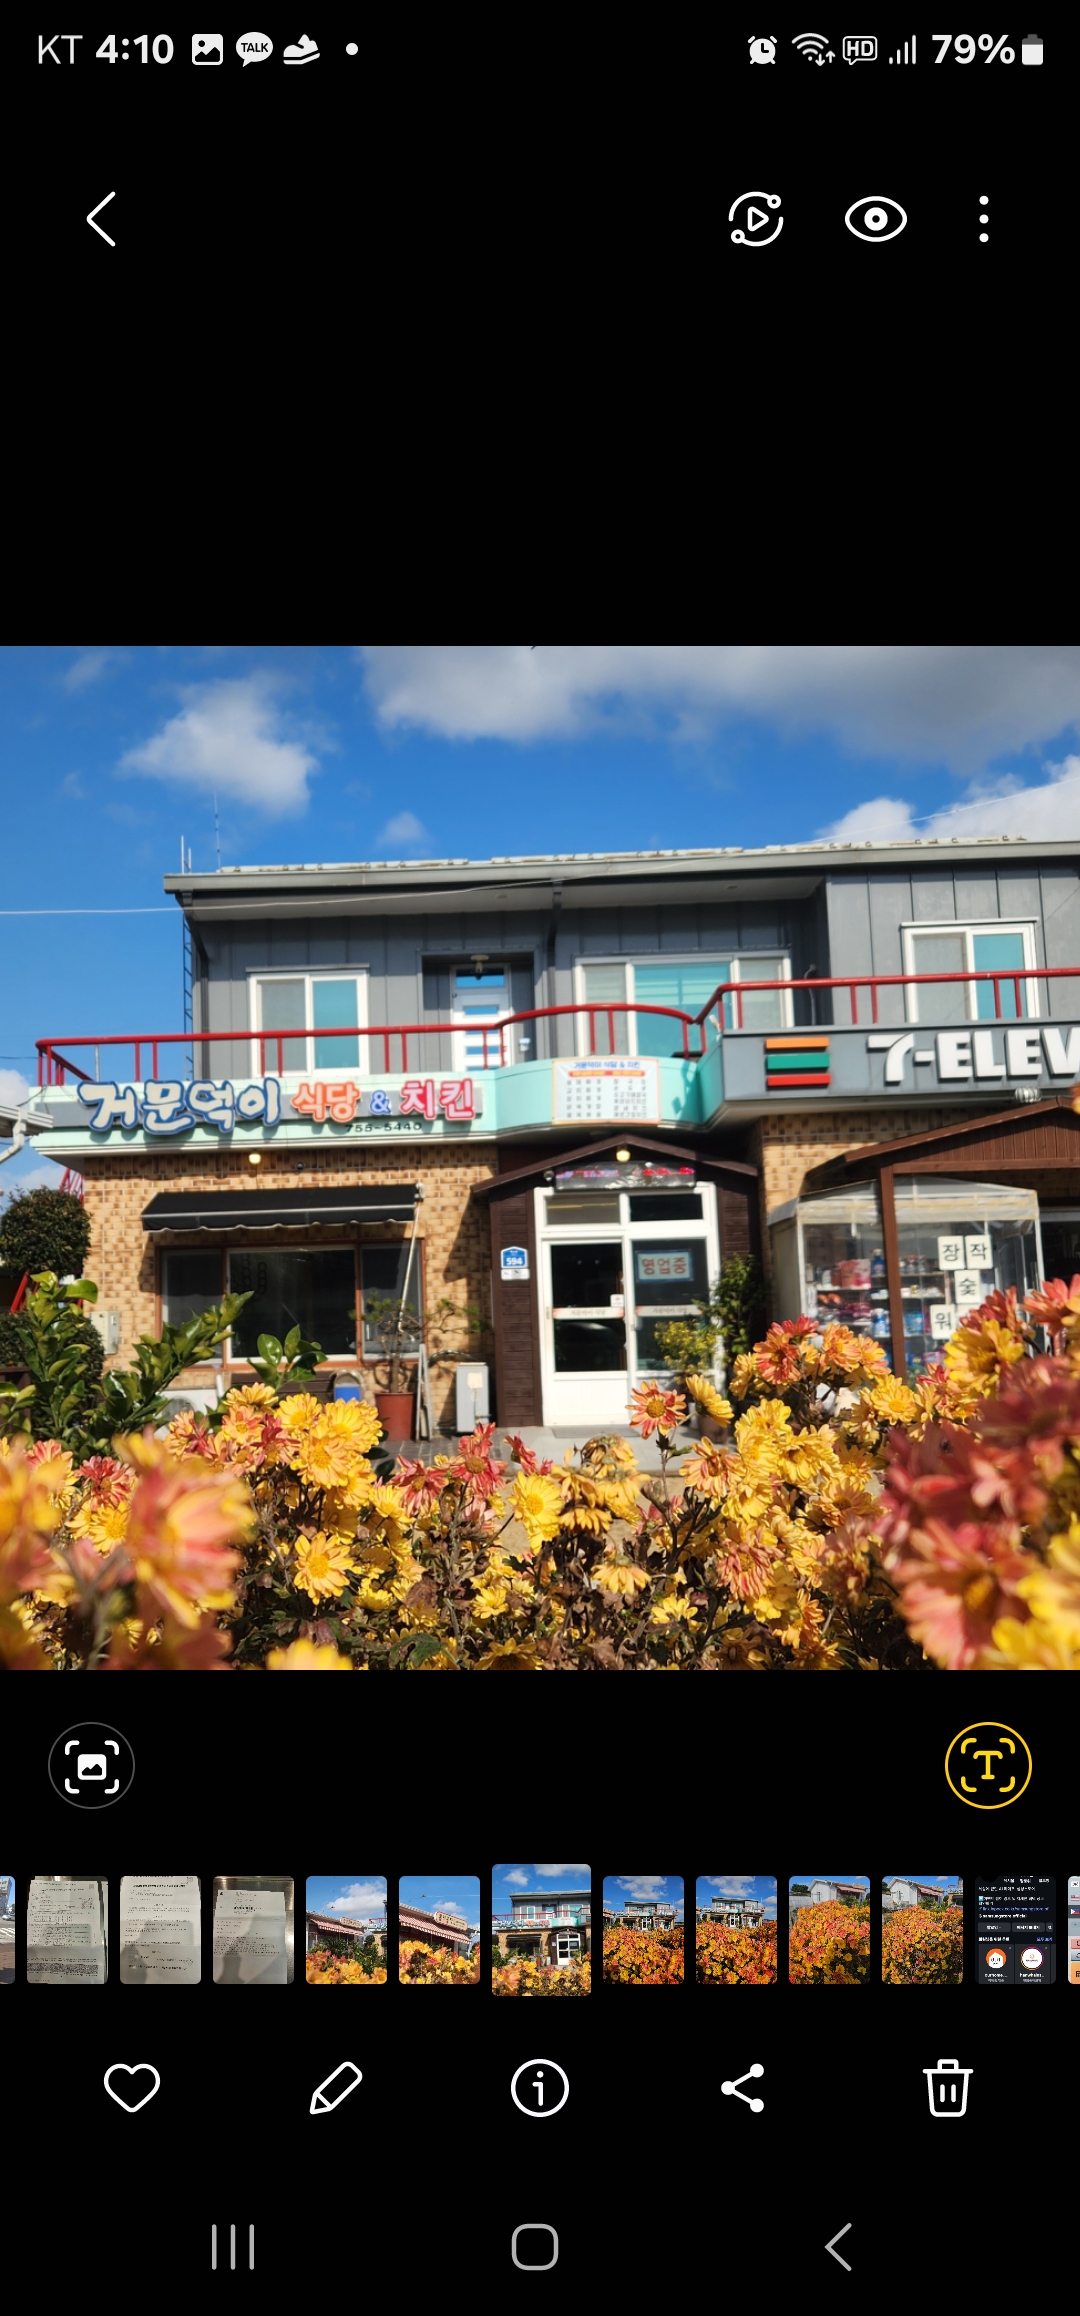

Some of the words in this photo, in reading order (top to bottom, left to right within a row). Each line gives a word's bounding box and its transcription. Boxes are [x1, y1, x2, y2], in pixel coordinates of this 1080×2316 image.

[39, 35, 83, 64] KT
[96, 34, 174, 64] 4:10
[241, 43, 268, 52] TALK
[847, 41, 873, 56] HD
[932, 34, 1015, 64] 79%
[77, 1077, 281, 1134] 거문덕이
[291, 1081, 360, 1123] 식당
[369, 1089, 391, 1115] &
[400, 1078, 477, 1121] 치킨
[345, 1121, 423, 1133] 755-5440
[505, 1257, 523, 1266] 594
[943, 1242, 988, 1262] 장작
[641, 1257, 687, 1276] 영업중
[958, 1277, 977, 1296] 숯
